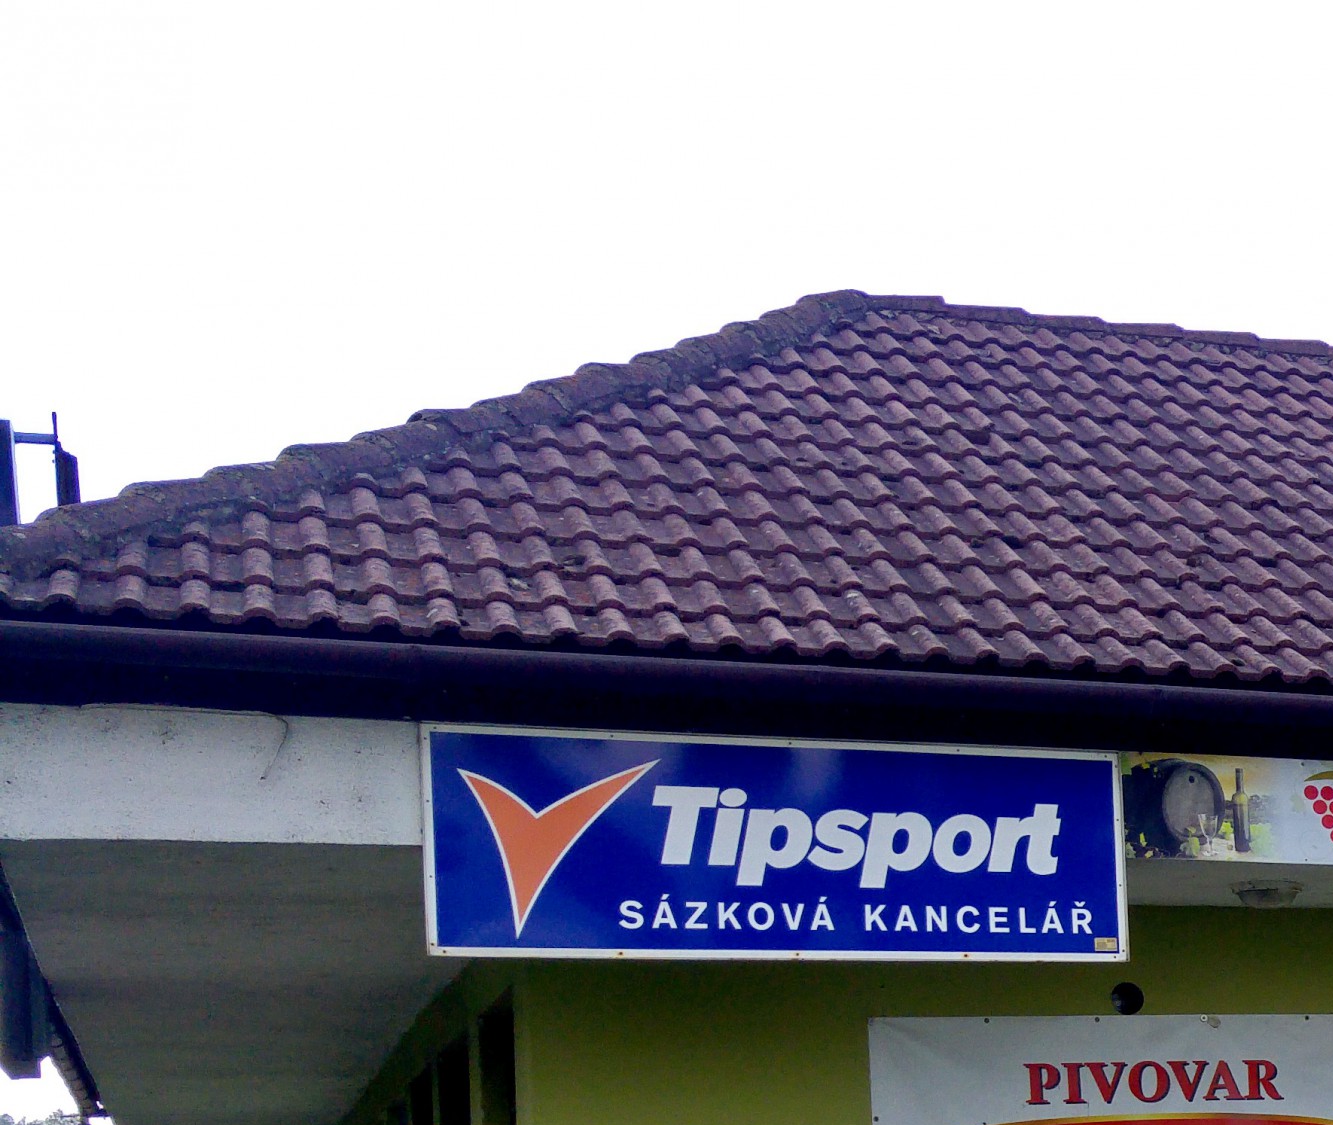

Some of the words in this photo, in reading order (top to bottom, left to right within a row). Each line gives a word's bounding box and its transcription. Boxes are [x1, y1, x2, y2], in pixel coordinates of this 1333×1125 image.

[652, 785, 1061, 888] Tipsport
[619, 895, 834, 931] SÁZKOVÁ
[864, 900, 1094, 935] KANCELÁŘ
[1023, 1059, 1285, 1105] PIVOVAR
